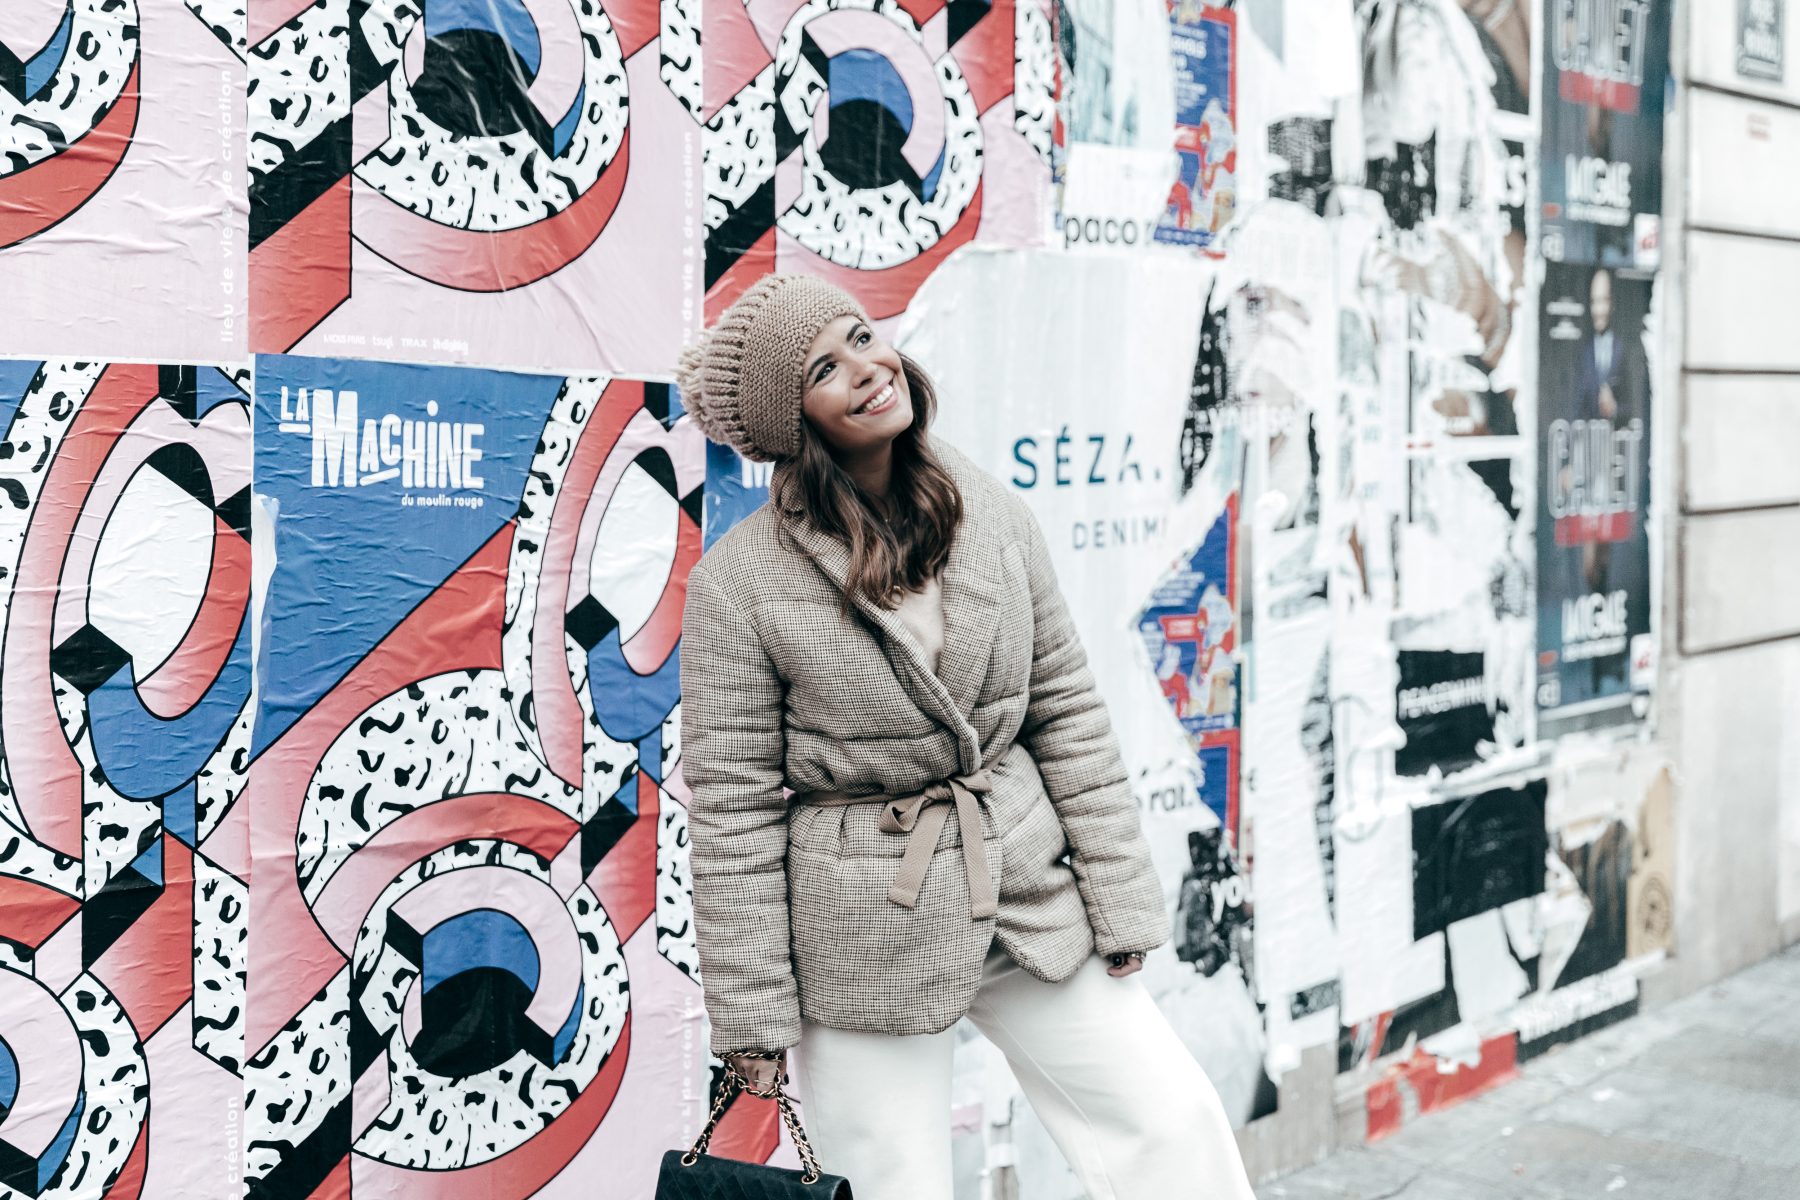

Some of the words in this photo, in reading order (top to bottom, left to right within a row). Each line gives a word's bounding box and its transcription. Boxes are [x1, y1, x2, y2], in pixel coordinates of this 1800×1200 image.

[218, 70, 232, 161] création
[220, 170, 234, 197] de
[682, 215, 694, 238] de
[1065, 217, 1138, 249] paco
[220, 227, 234, 259] vie
[220, 267, 234, 295] de
[220, 304, 234, 342] lieu
[682, 297, 693, 322] de
[401, 337, 428, 348] TRAX
[279, 386, 310, 432] LA
[401, 493, 414, 506] du
[416, 493, 452, 507] moulin
[454, 496, 484, 510] rouge
[224, 1096, 239, 1184] création
